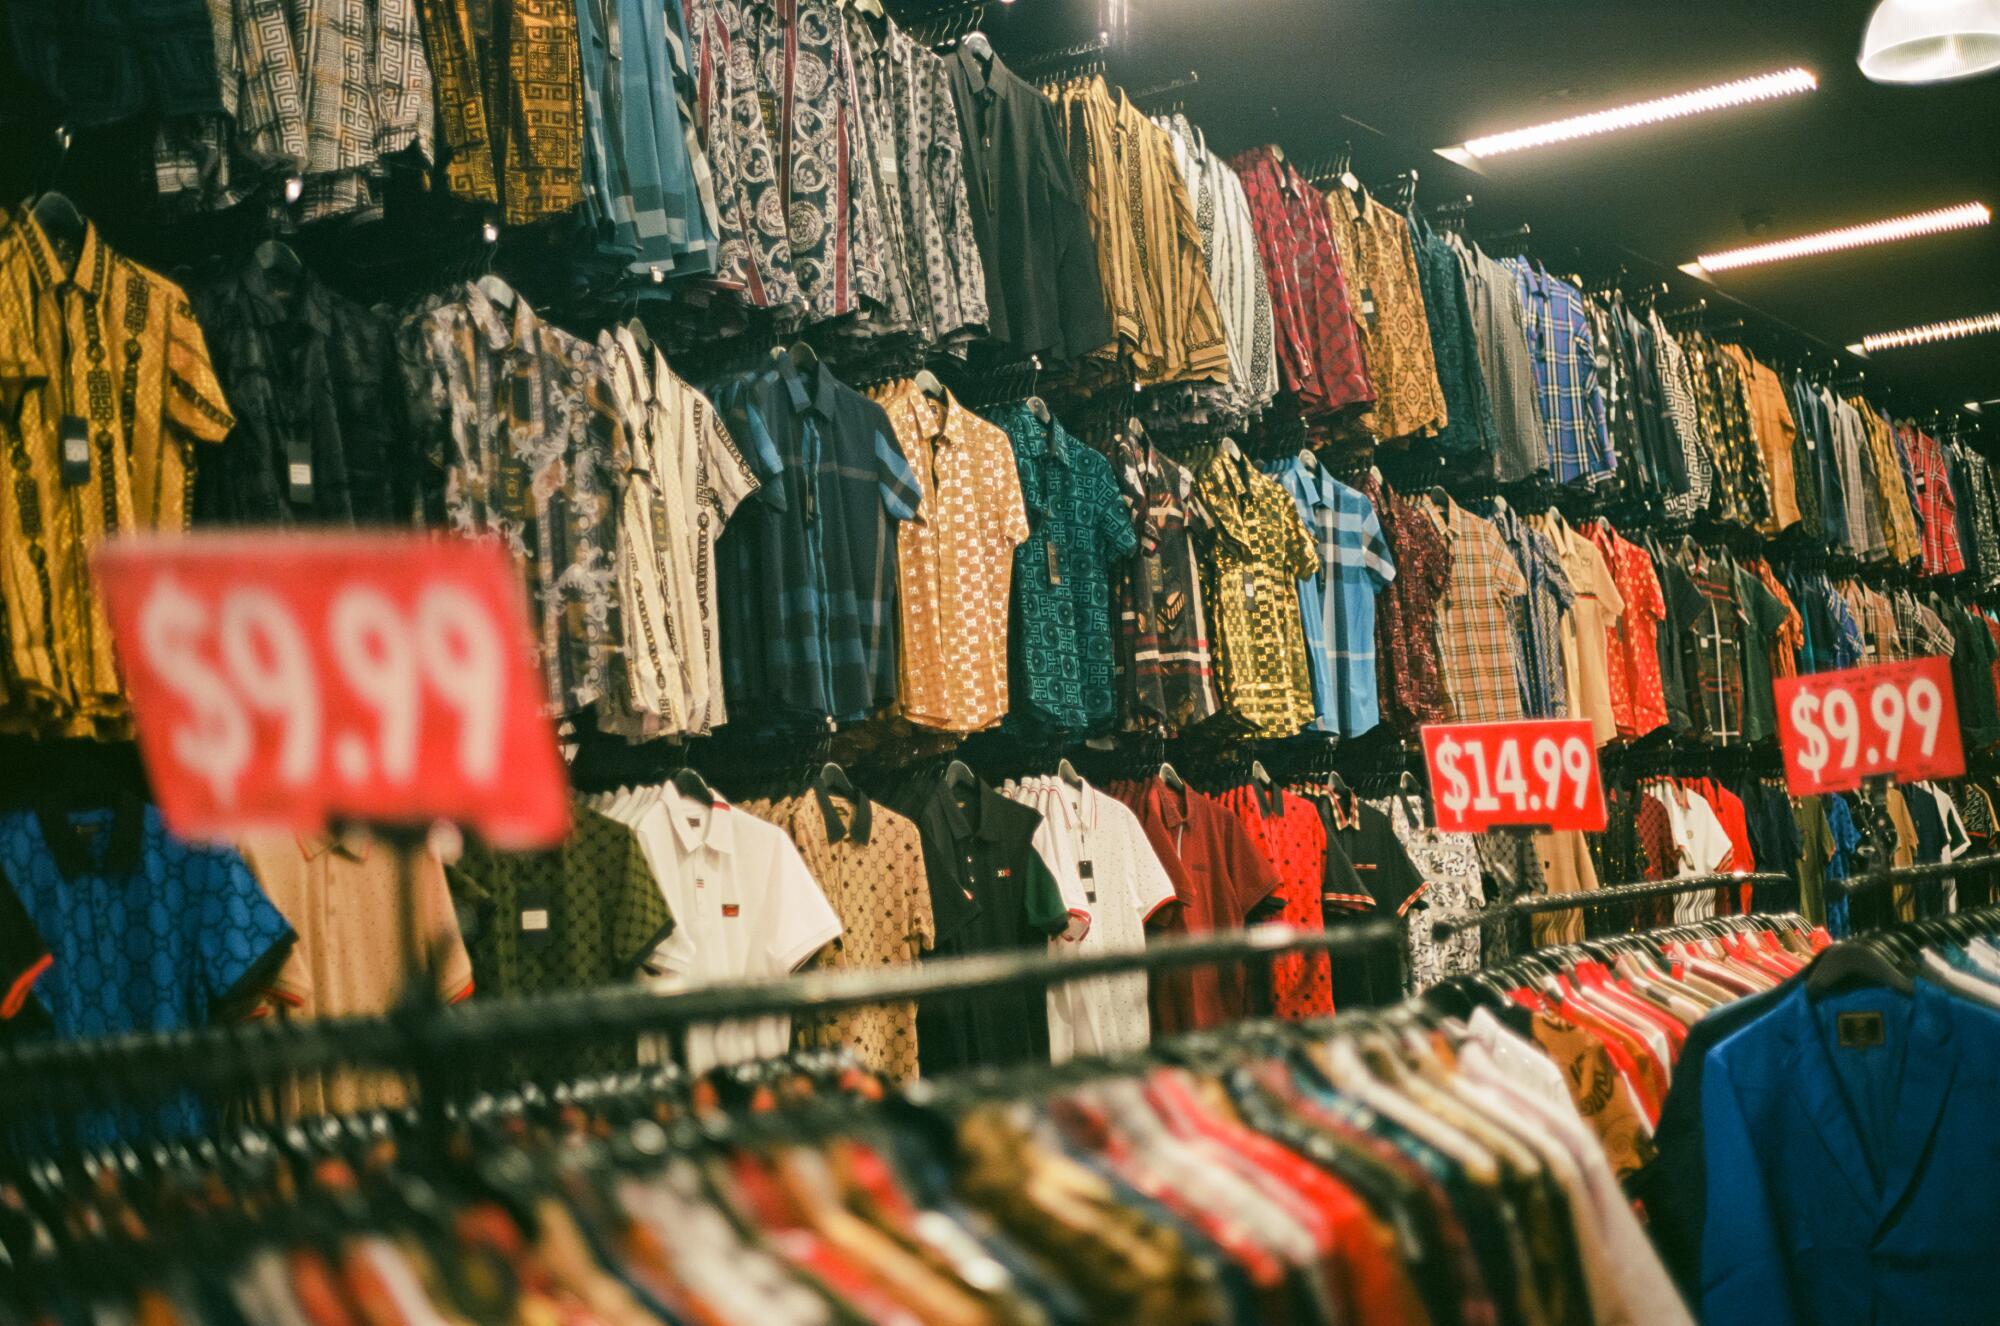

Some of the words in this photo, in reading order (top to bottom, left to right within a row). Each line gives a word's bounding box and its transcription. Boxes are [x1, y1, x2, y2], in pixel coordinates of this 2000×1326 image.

[138, 570, 508, 807] $9.99
[1791, 677, 1942, 784] $9.99
[1436, 734, 1591, 823] $14.99
